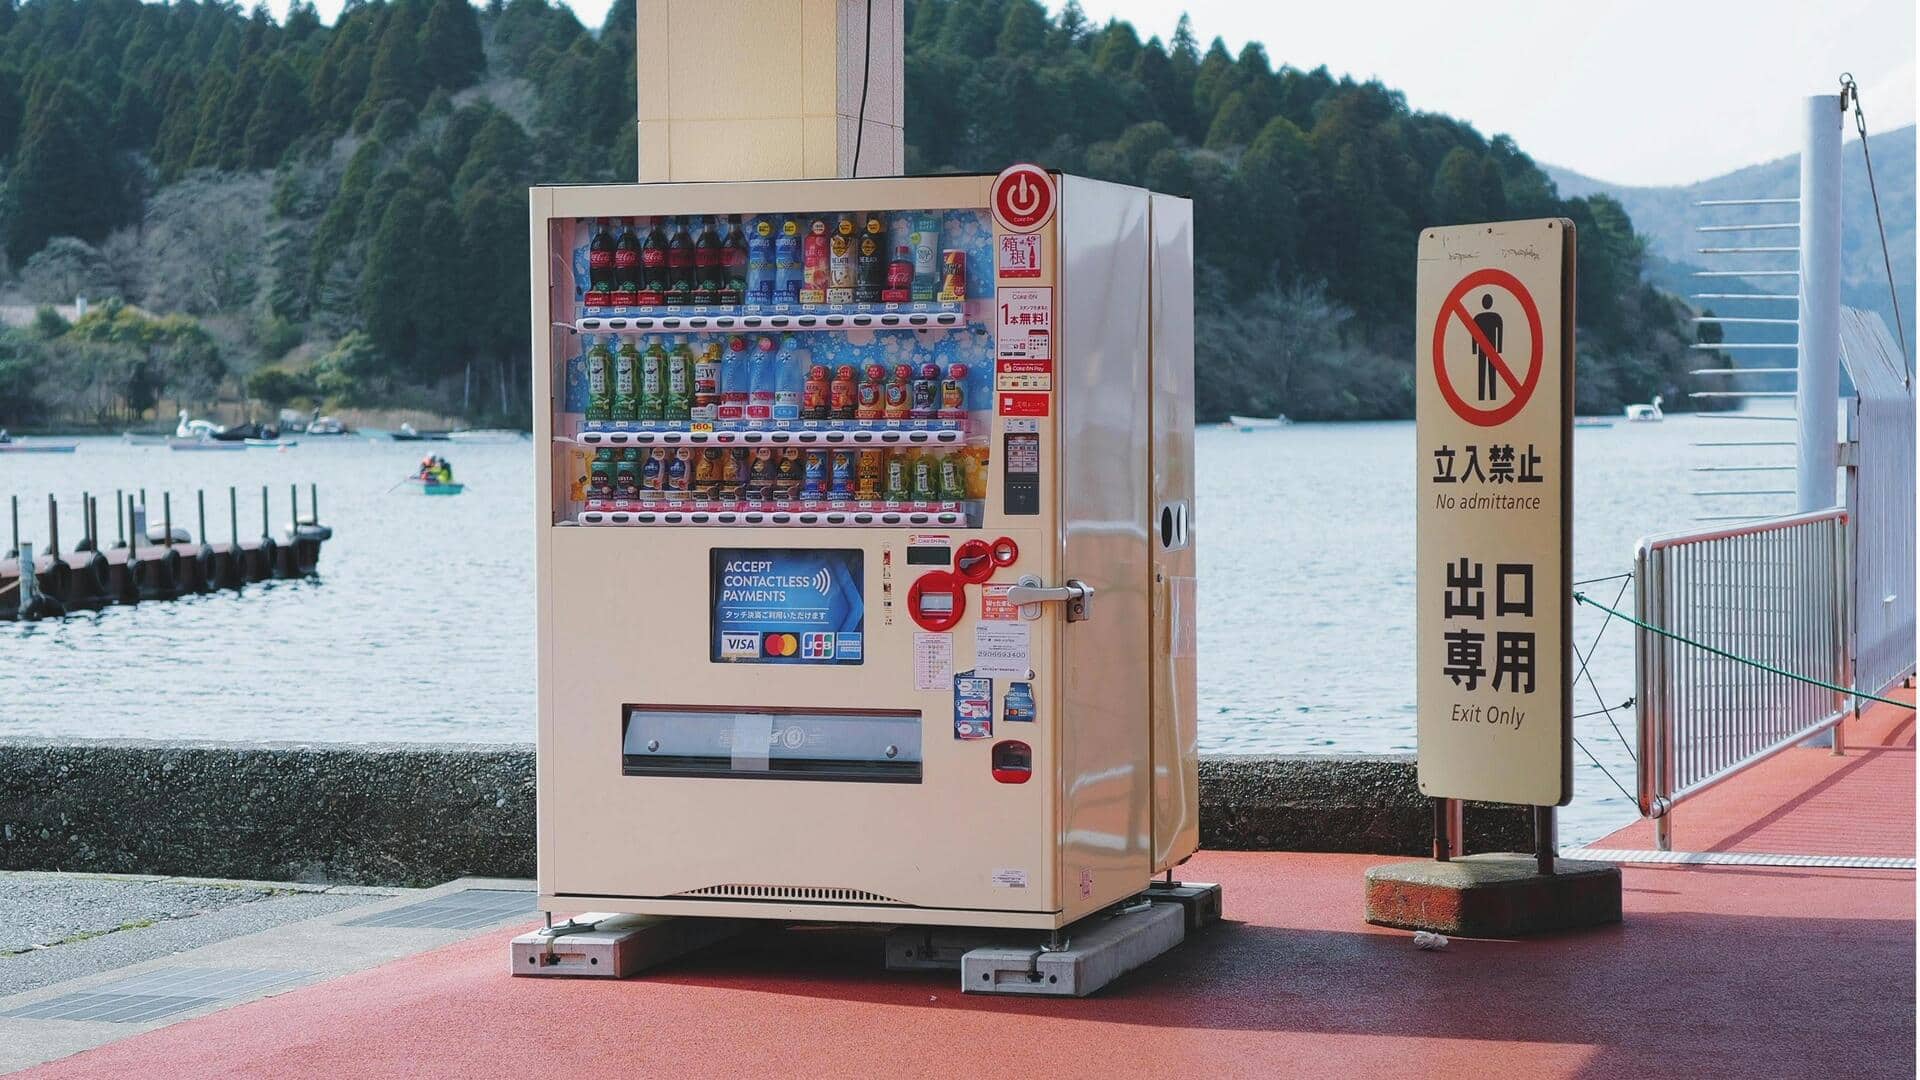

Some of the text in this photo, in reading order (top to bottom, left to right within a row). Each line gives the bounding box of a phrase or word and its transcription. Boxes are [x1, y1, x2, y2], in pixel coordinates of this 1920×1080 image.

[1433, 444, 1543, 484] 立入禁止
[1436, 492, 1540, 510] No admittance
[725, 561, 772, 572] ACCEPT
[724, 576, 810, 587] CONTACTLESS
[1444, 557, 1534, 620] 出口
[723, 591, 786, 601] PAYMENTS
[728, 639, 755, 650] VISA
[803, 641, 832, 650] JCB
[1443, 629, 1536, 694] 専用
[1451, 703, 1525, 730] Exit Only
